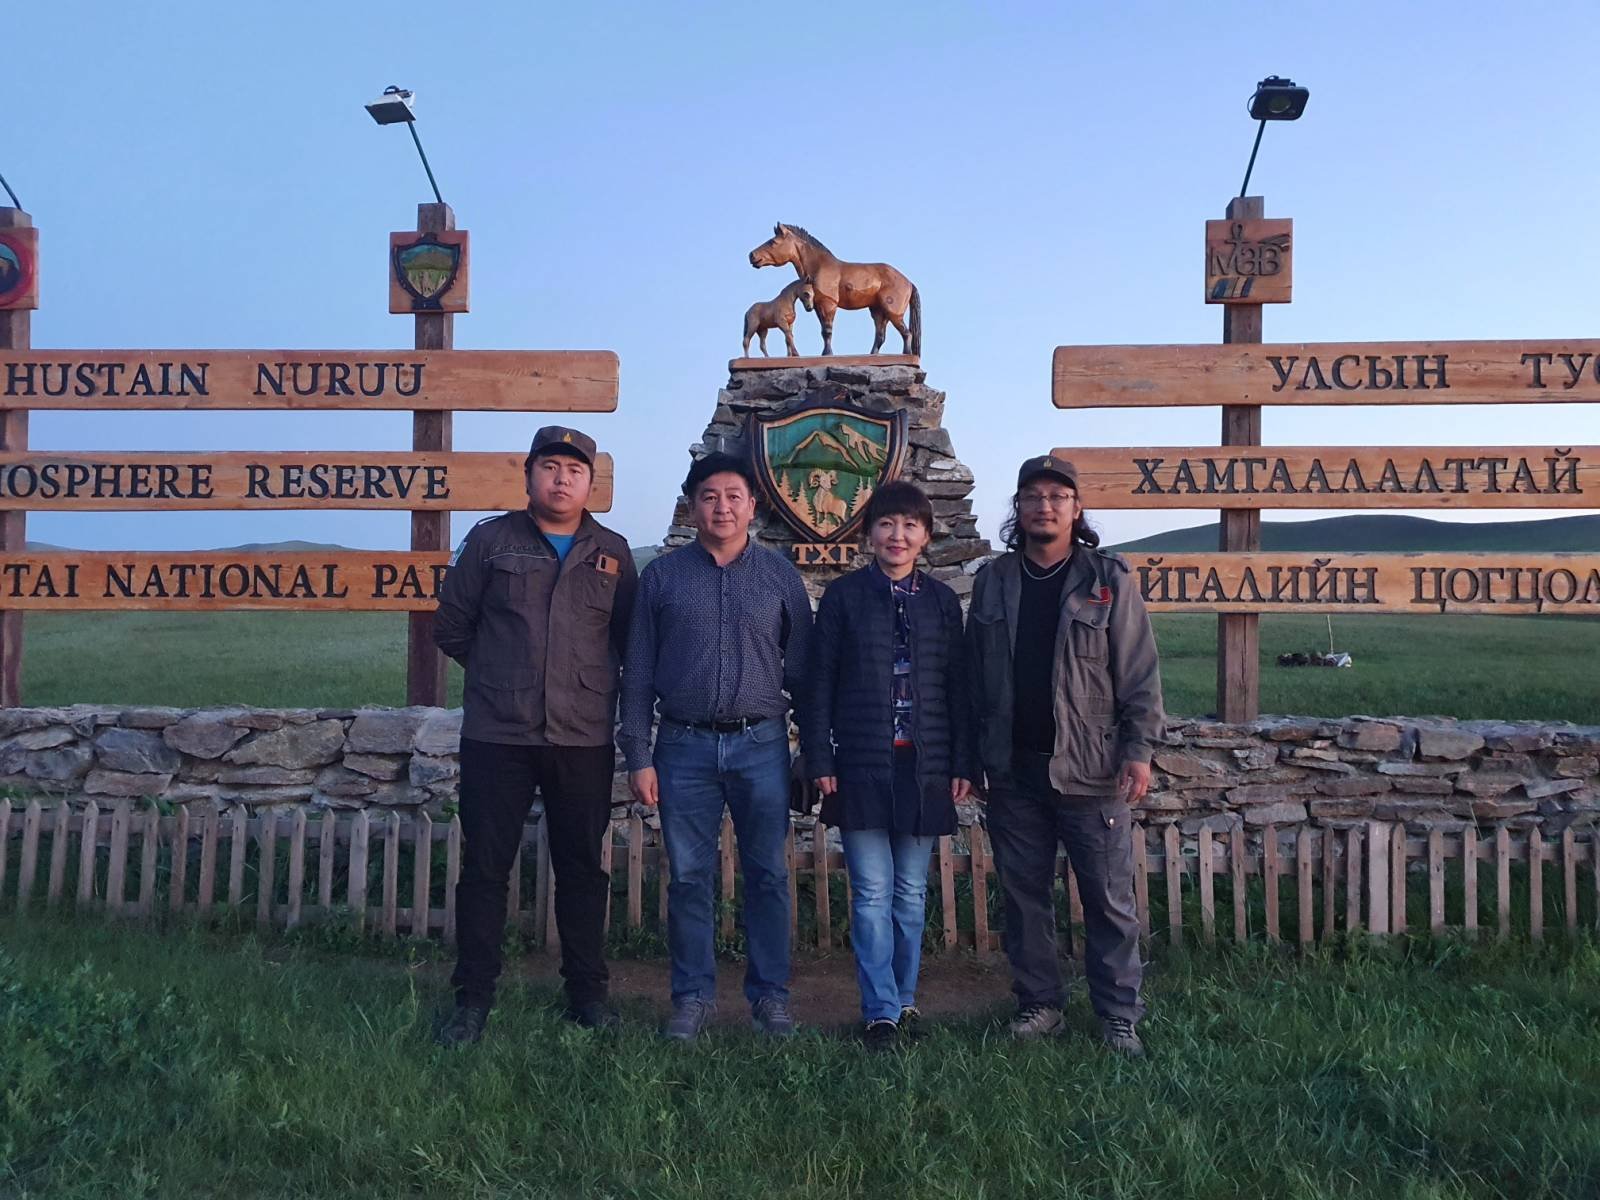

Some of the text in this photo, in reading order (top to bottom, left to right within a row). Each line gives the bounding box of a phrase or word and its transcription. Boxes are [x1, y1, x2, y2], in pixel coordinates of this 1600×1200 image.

[4, 362, 426, 397] HUSTAIN NURUU
[1266, 353, 1600, 392] УЛСЫН ТУ
[244, 463, 450, 499] RESERVE
[1131, 448, 1584, 494] ХАМГААЛАЛТТАЙ
[792, 543, 859, 565] ТХГ
[0, 563, 80, 598] TAI
[102, 564, 349, 598] NATIONAL
[1136, 557, 1380, 603] ЙГАЛИЙН
